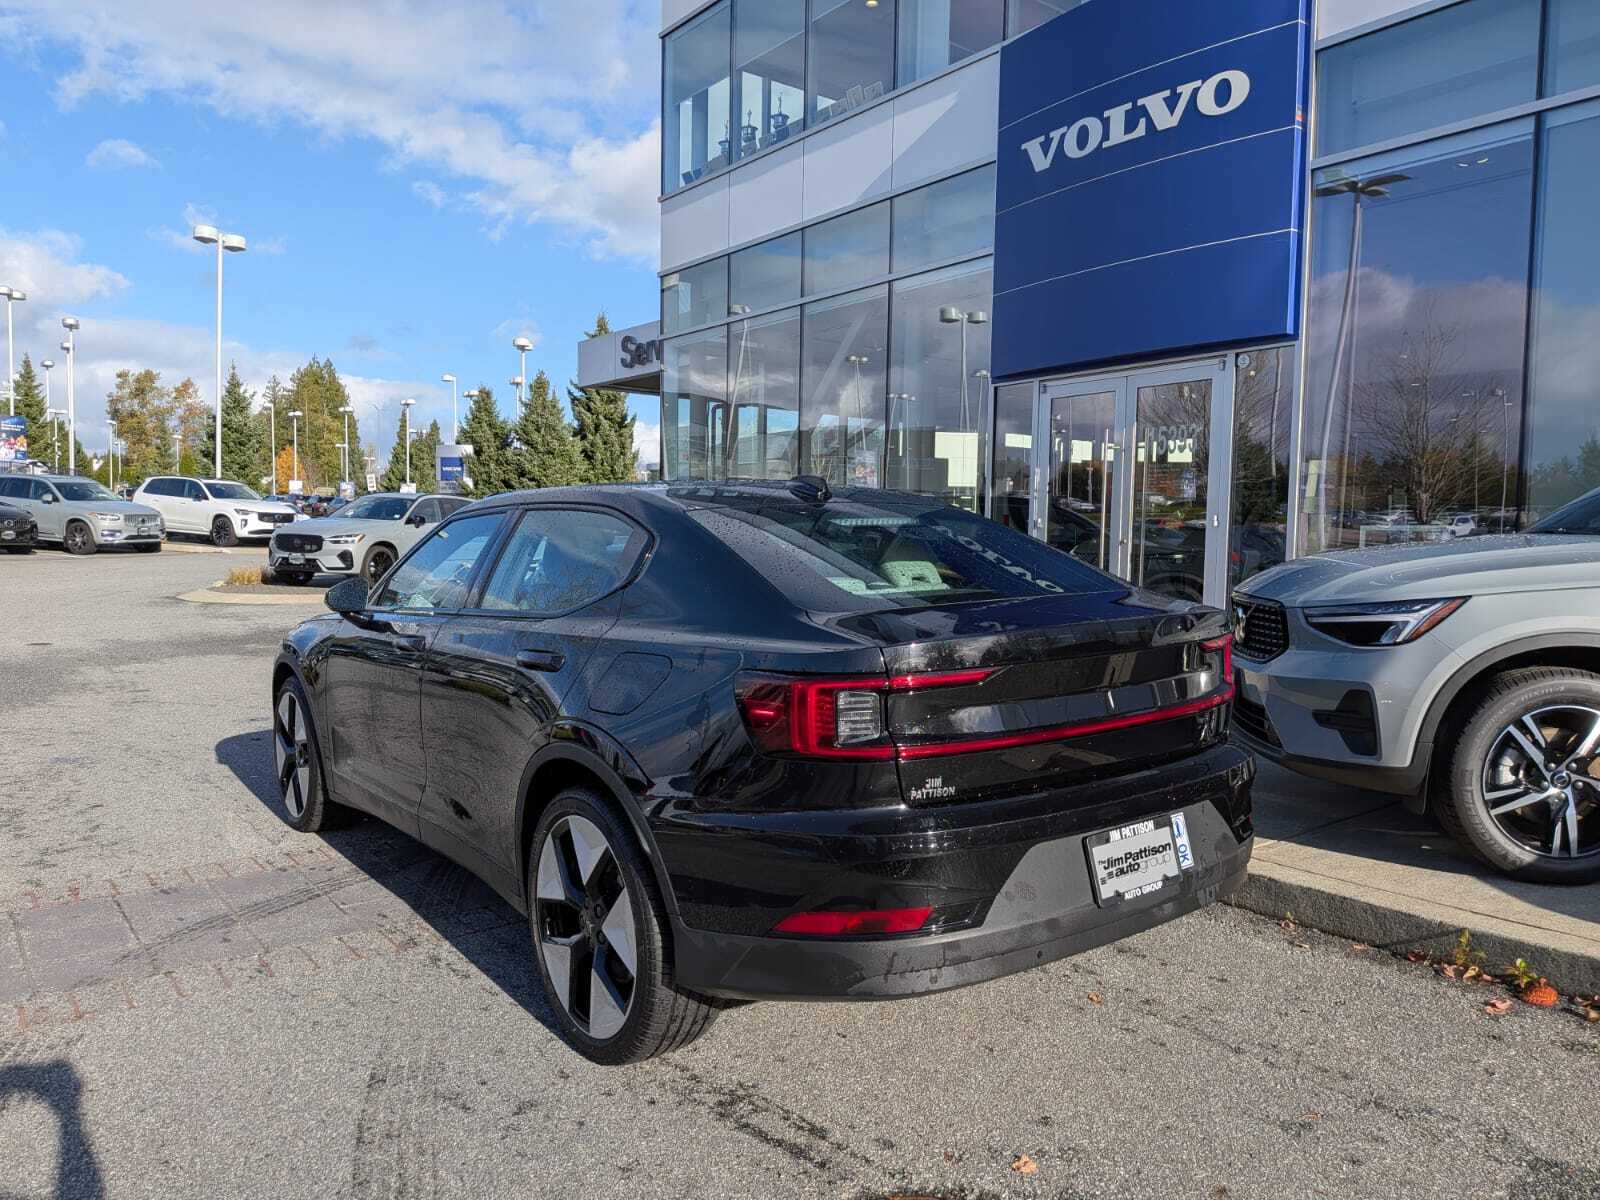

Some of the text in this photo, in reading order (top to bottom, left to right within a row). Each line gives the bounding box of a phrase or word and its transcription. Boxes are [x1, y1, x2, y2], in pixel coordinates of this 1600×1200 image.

[1021, 70, 1250, 172] VOLVO
[910, 785, 956, 800] PATTISON
[925, 776, 942, 789] JIM
[1109, 820, 1155, 842] JIM PATTISON
[1178, 843, 1190, 863] OK
[1124, 880, 1163, 900] AUTO GROUP
